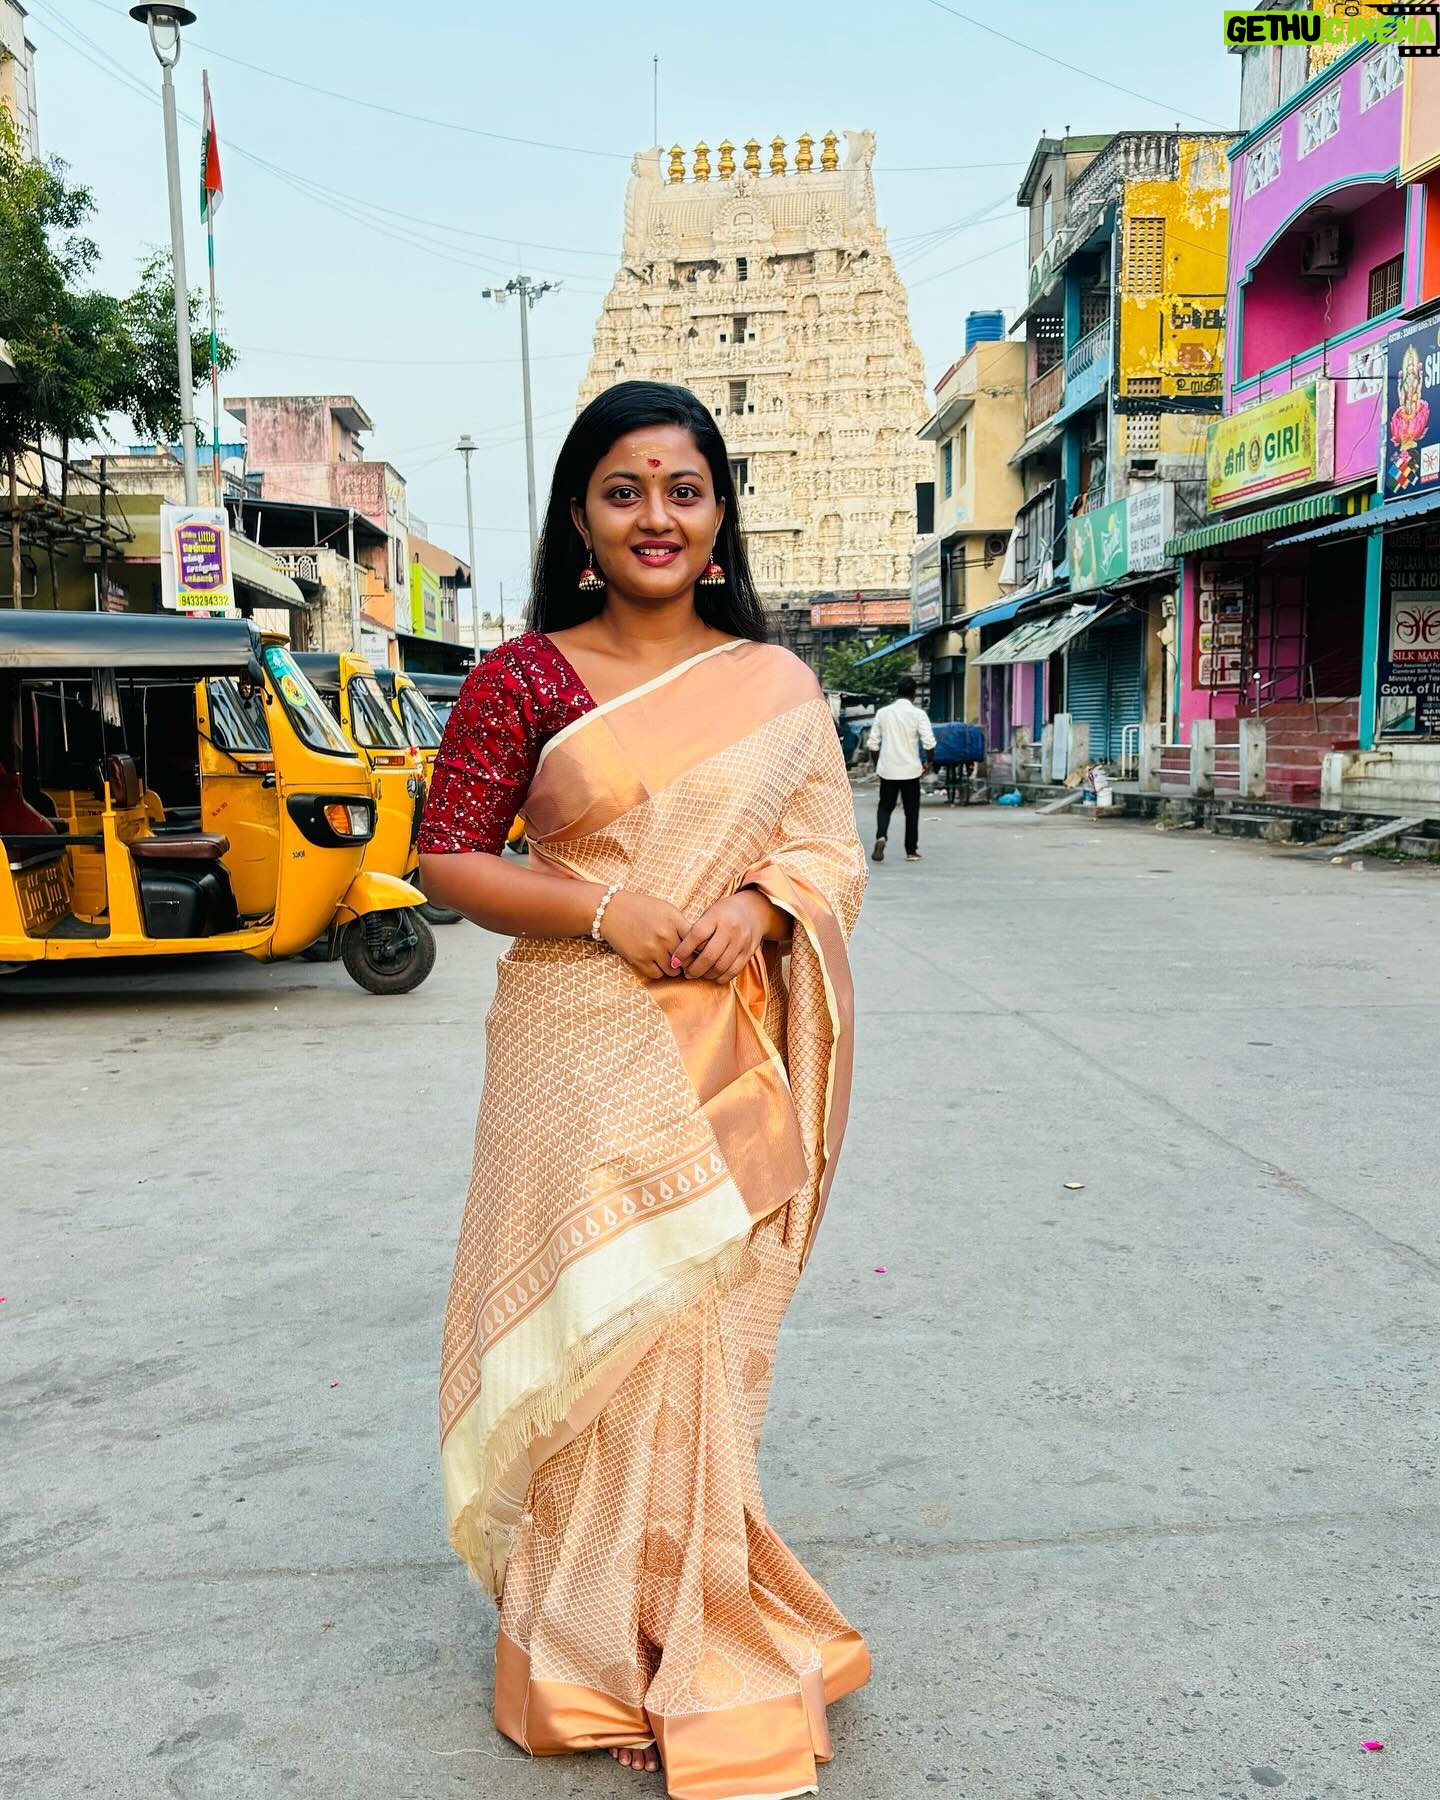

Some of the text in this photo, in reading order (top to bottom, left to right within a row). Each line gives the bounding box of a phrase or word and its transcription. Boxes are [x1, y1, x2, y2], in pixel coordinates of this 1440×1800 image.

[1264, 422, 1300, 462] GIRI
[1223, 441, 1246, 478] கிரி
[1390, 572, 1440, 588] SILK HO
[1393, 651, 1415, 661] SILK
[1381, 683, 1414, 694] Govt.
[1416, 683, 1430, 694] of
